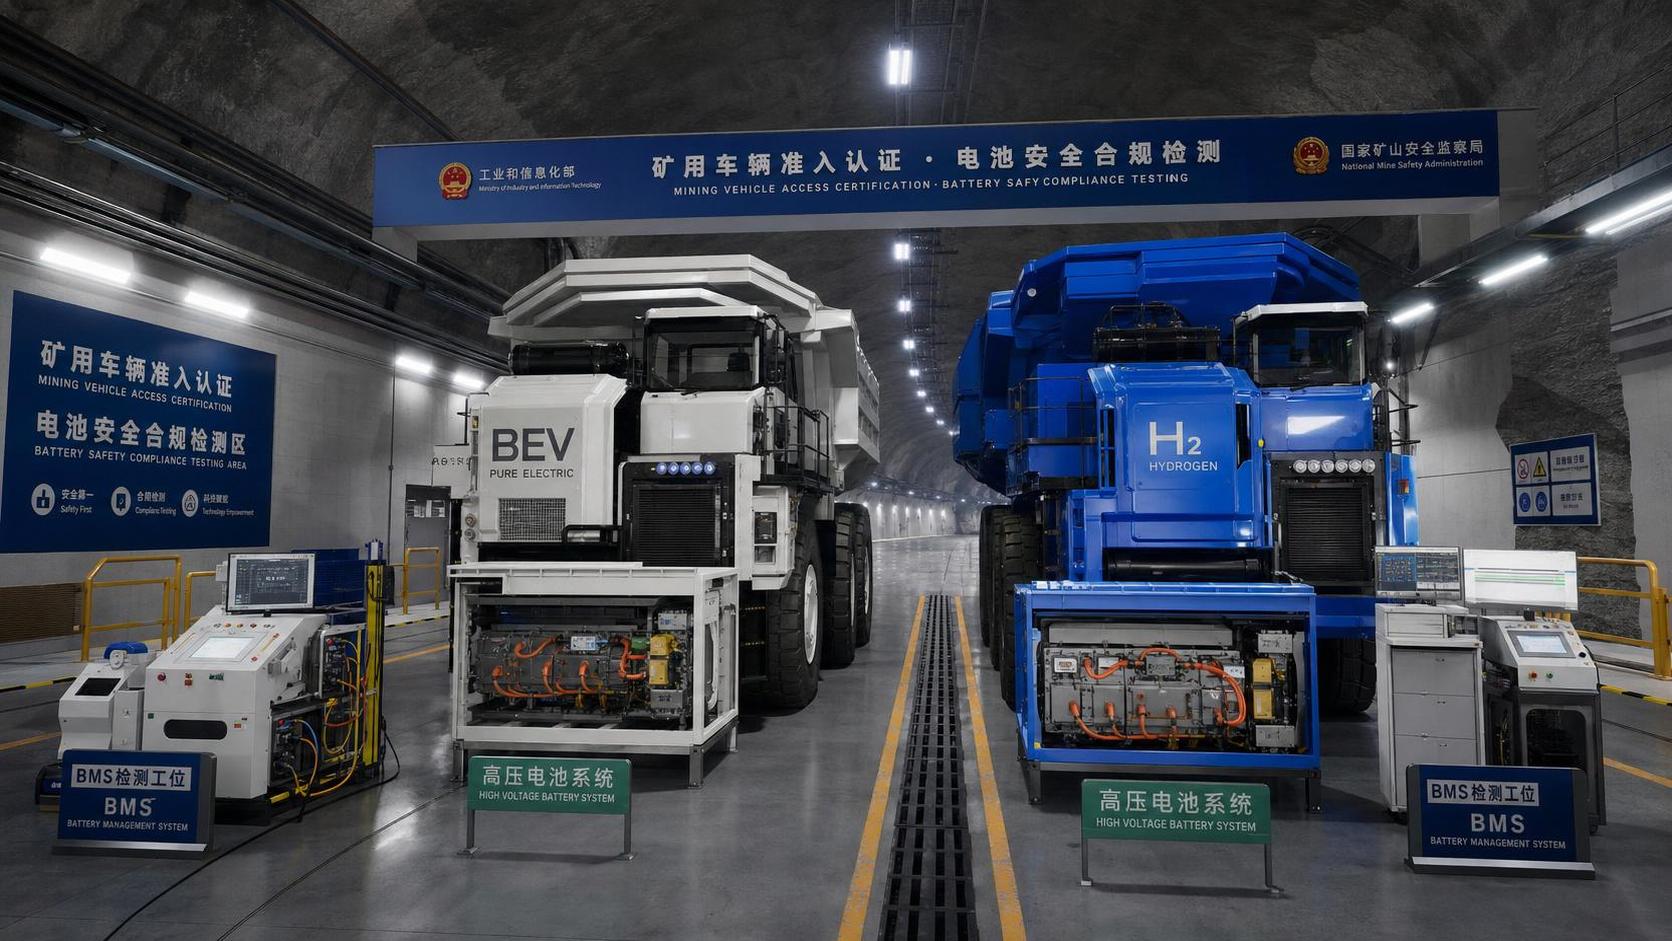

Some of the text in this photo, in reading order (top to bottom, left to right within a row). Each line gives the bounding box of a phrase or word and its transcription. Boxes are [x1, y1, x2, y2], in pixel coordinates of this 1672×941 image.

[652, 149, 901, 179] 矿用车辆准入认证
[957, 139, 1221, 170] 电池安全合规检测
[1341, 139, 1483, 159] 国家矿山安全监察局
[479, 165, 575, 181] 工业和信息化部
[1341, 158, 1484, 171] National Mine Safety Administration
[673, 185, 718, 196] MINING
[723, 184, 775, 195] VEHICLE
[781, 182, 829, 193] ACCESS
[835, 180, 931, 192] CERTIFICATION
[943, 178, 1001, 189] BATTERY
[1007, 177, 1038, 188] SAFY
[1043, 174, 1125, 187] COMPLIANCE
[1131, 173, 1189, 185] TESTING
[40, 340, 233, 398] 矿用车辆准入认证
[38, 375, 232, 413] MINING VEHICLE ACCESS CERTIFICATION
[36, 409, 247, 455] 电池安全合规检测区
[491, 427, 575, 462] BEV
[34, 446, 247, 471] BATTERY SAFETY COMPLIANCE TESTING AREA
[1150, 461, 1218, 472] HYDROGEN
[489, 468, 574, 478] PURE ELECTRIC
[76, 767, 186, 788] BMS检测工位
[482, 764, 614, 789] 高压电池系统
[479, 791, 615, 803] HIGH VOLTAGE BATTERY SYSTEM
[1099, 788, 1252, 815] 高压电池系统
[1431, 783, 1536, 803] BMS检测工位
[104, 797, 153, 816] BMS
[67, 819, 189, 831] BATTERY MANAGEMENT SYSTEM
[1096, 817, 1257, 832] HIGH VOLTAGE BATTERY SYSTEM
[1471, 813, 1526, 834] BMS
[1430, 836, 1566, 849] BATTERY MANAGEMENT SYSTEM
